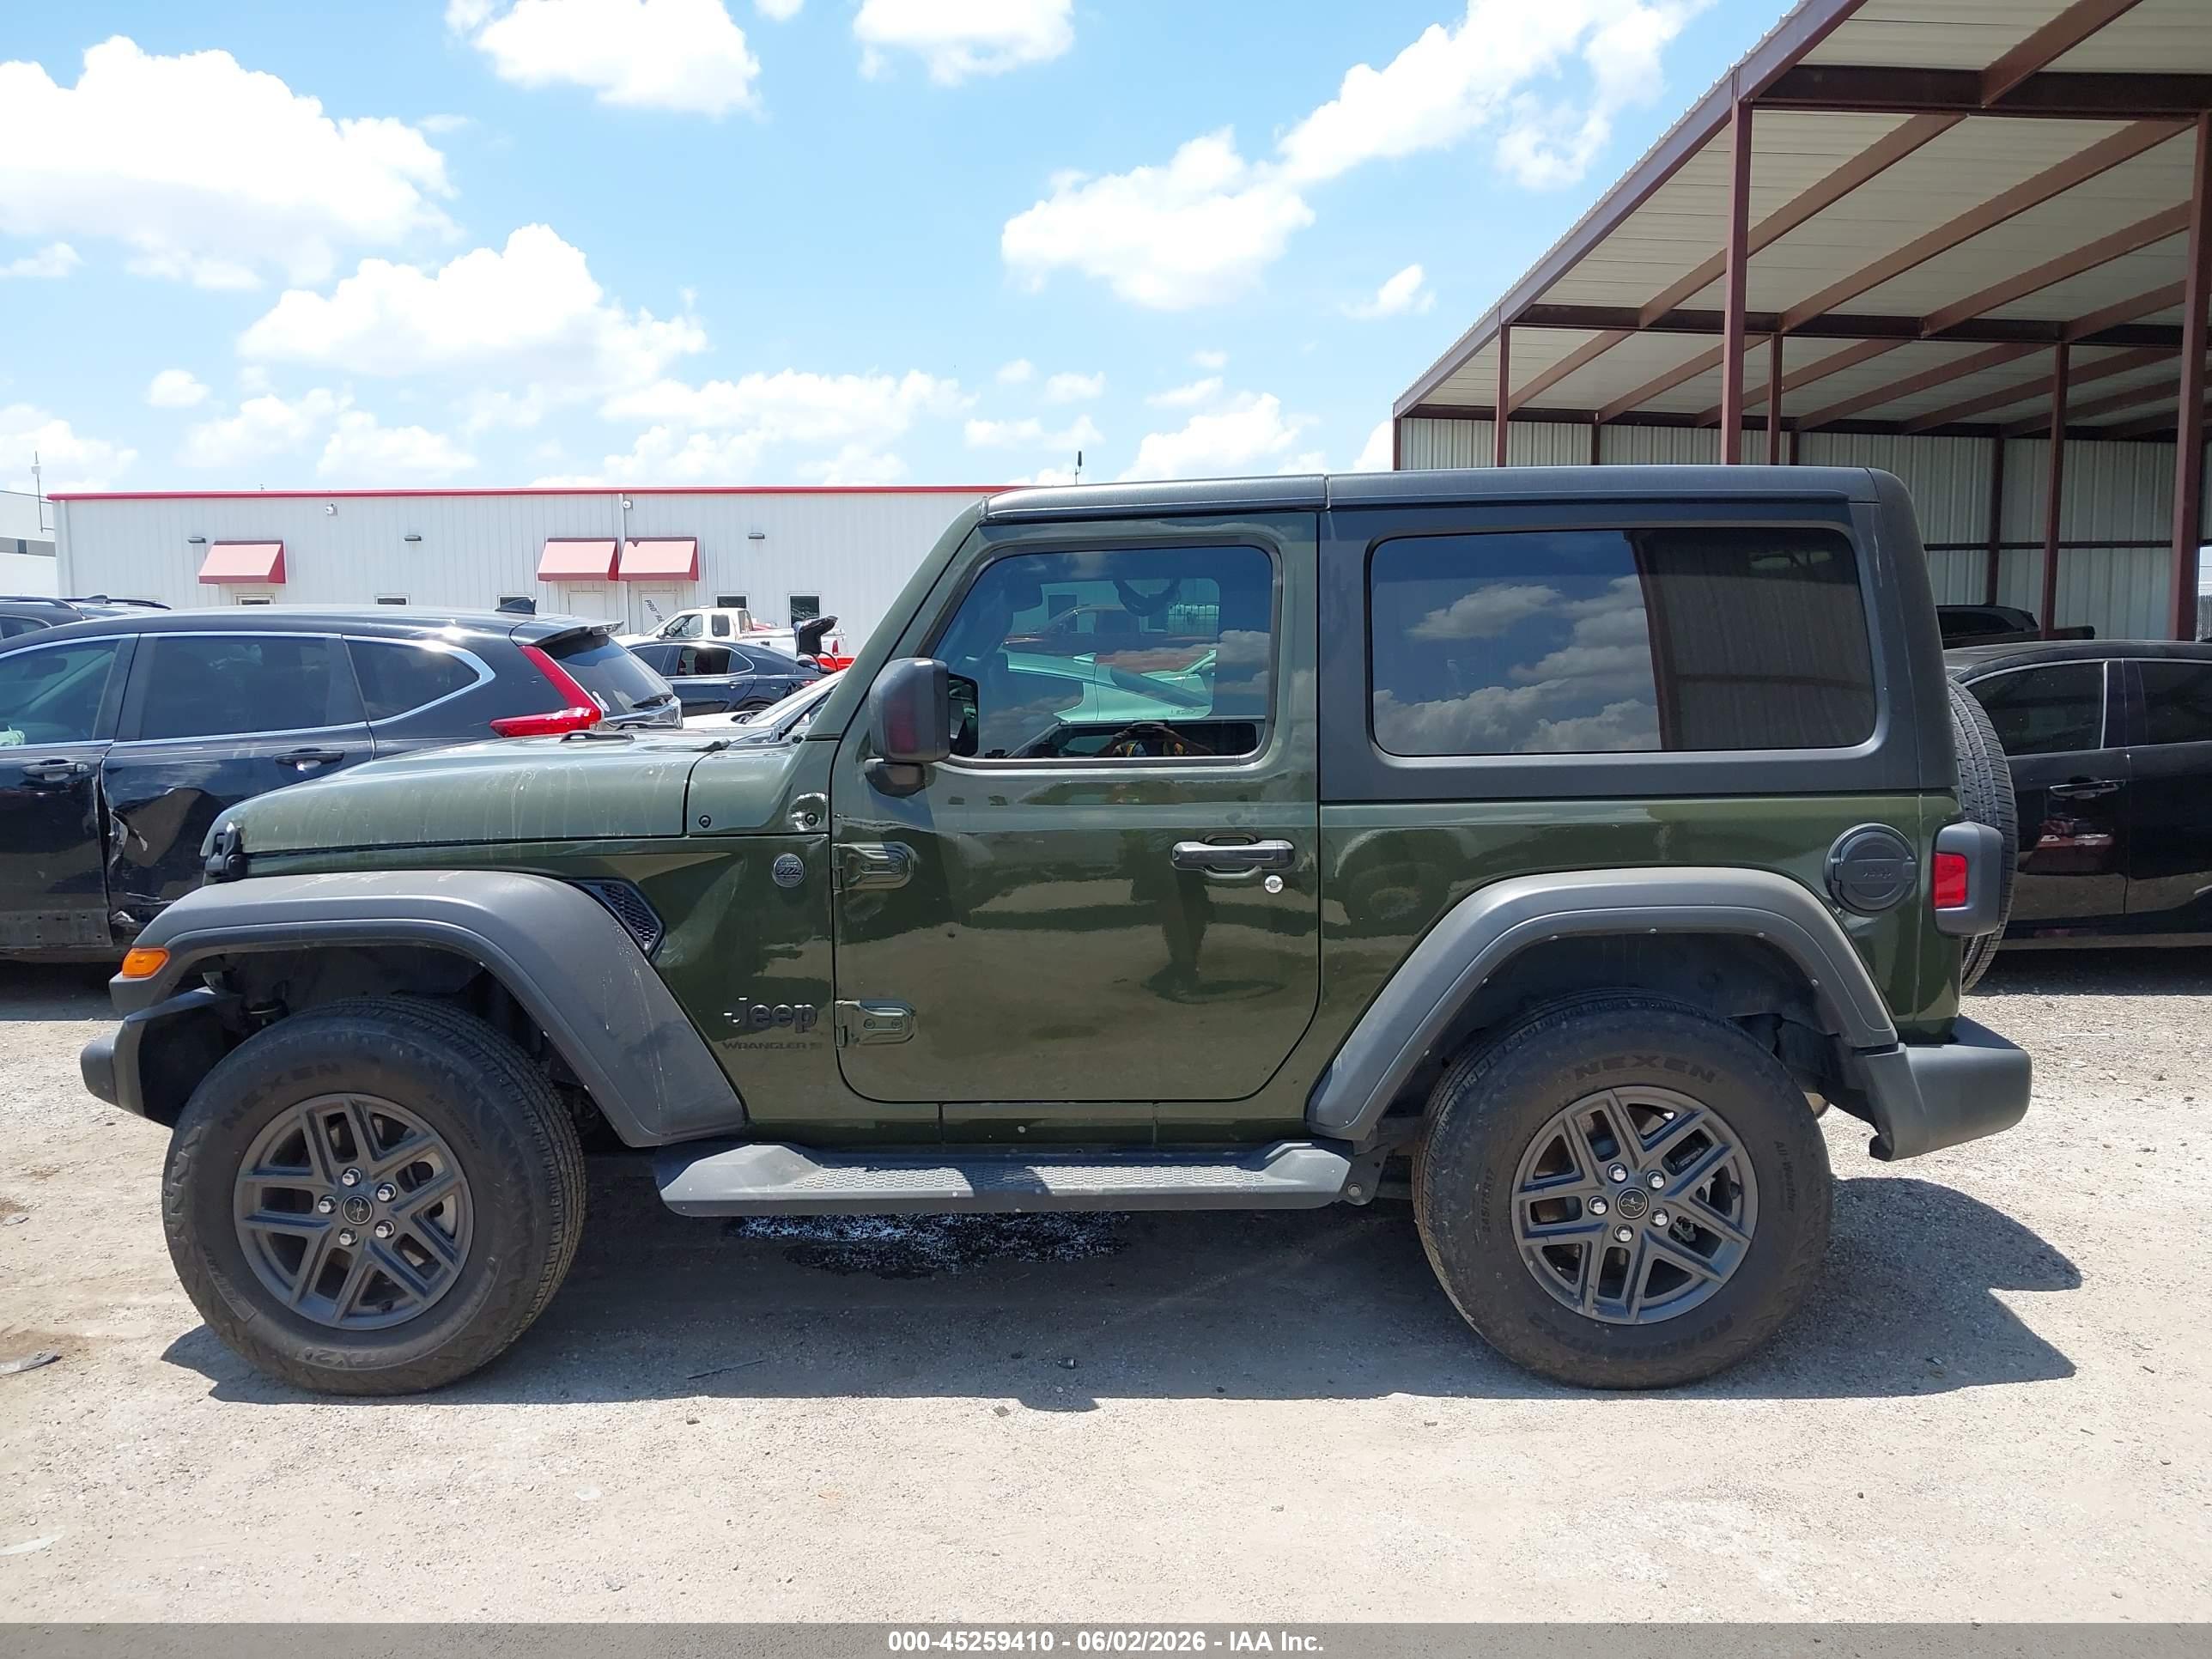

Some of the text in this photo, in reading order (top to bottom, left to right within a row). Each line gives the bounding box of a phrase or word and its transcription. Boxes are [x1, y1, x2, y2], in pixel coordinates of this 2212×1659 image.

[723, 996, 818, 1034] Jeep
[721, 1041, 807, 1050] WRANGLER
[1573, 1054, 1717, 1085] NEXEN
